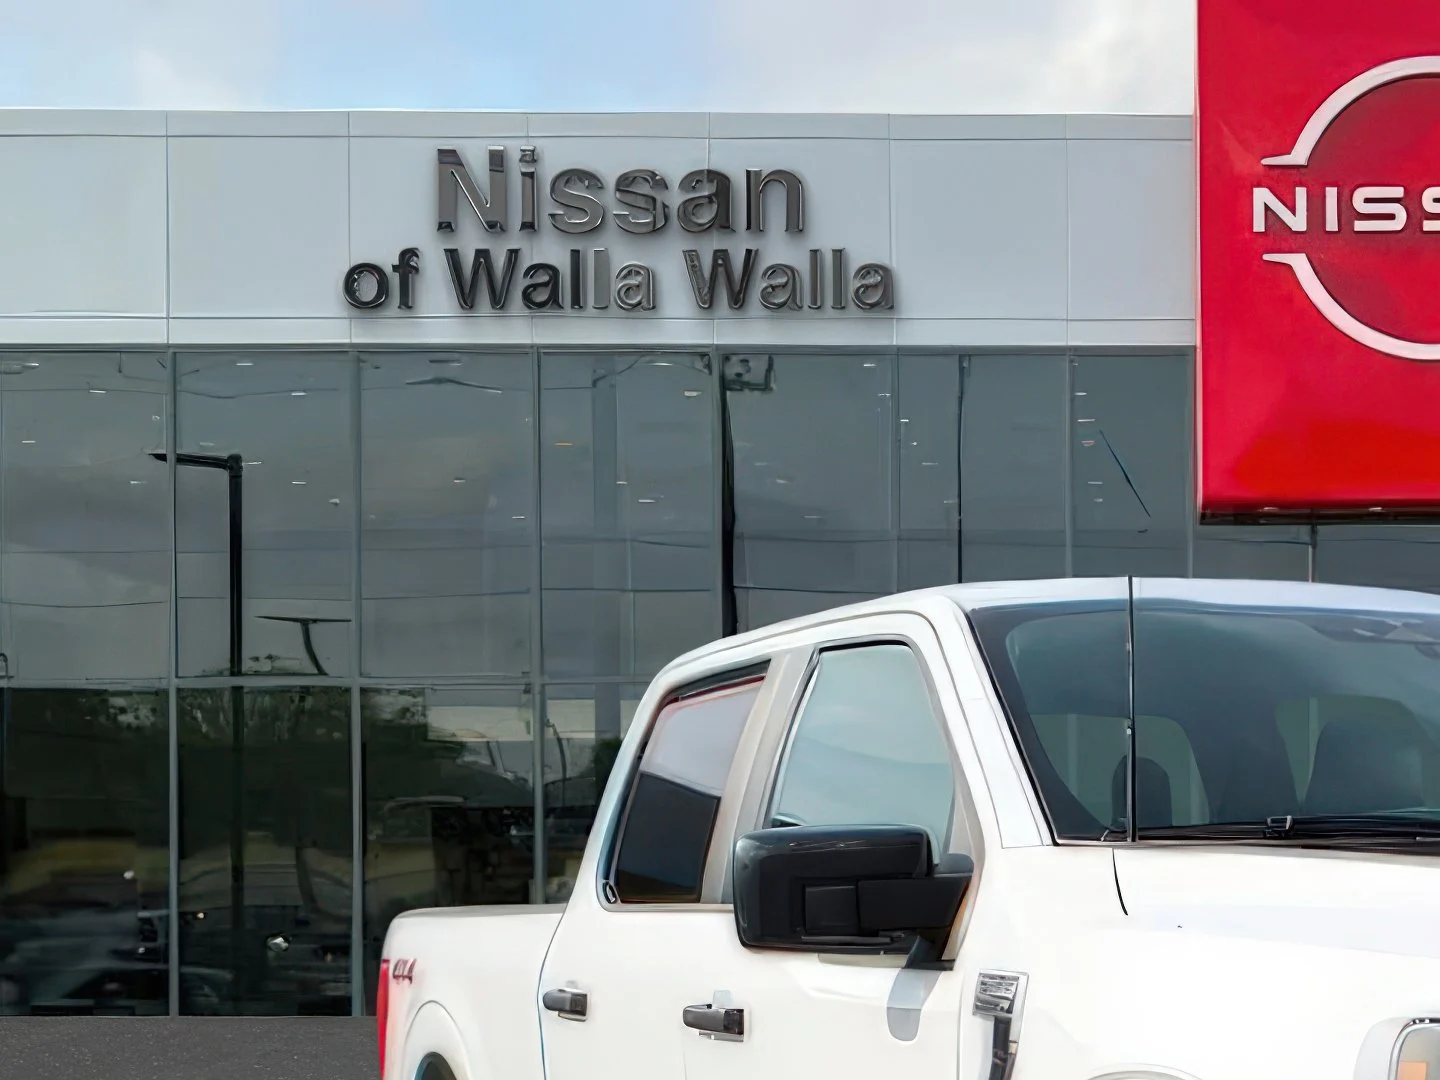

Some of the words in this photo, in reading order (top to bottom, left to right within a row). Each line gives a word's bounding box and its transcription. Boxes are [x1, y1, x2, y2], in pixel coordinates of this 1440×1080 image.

[437, 145, 805, 234] Nissan
[343, 247, 420, 310] of
[444, 248, 656, 311] Walla
[682, 248, 895, 311] Walla
